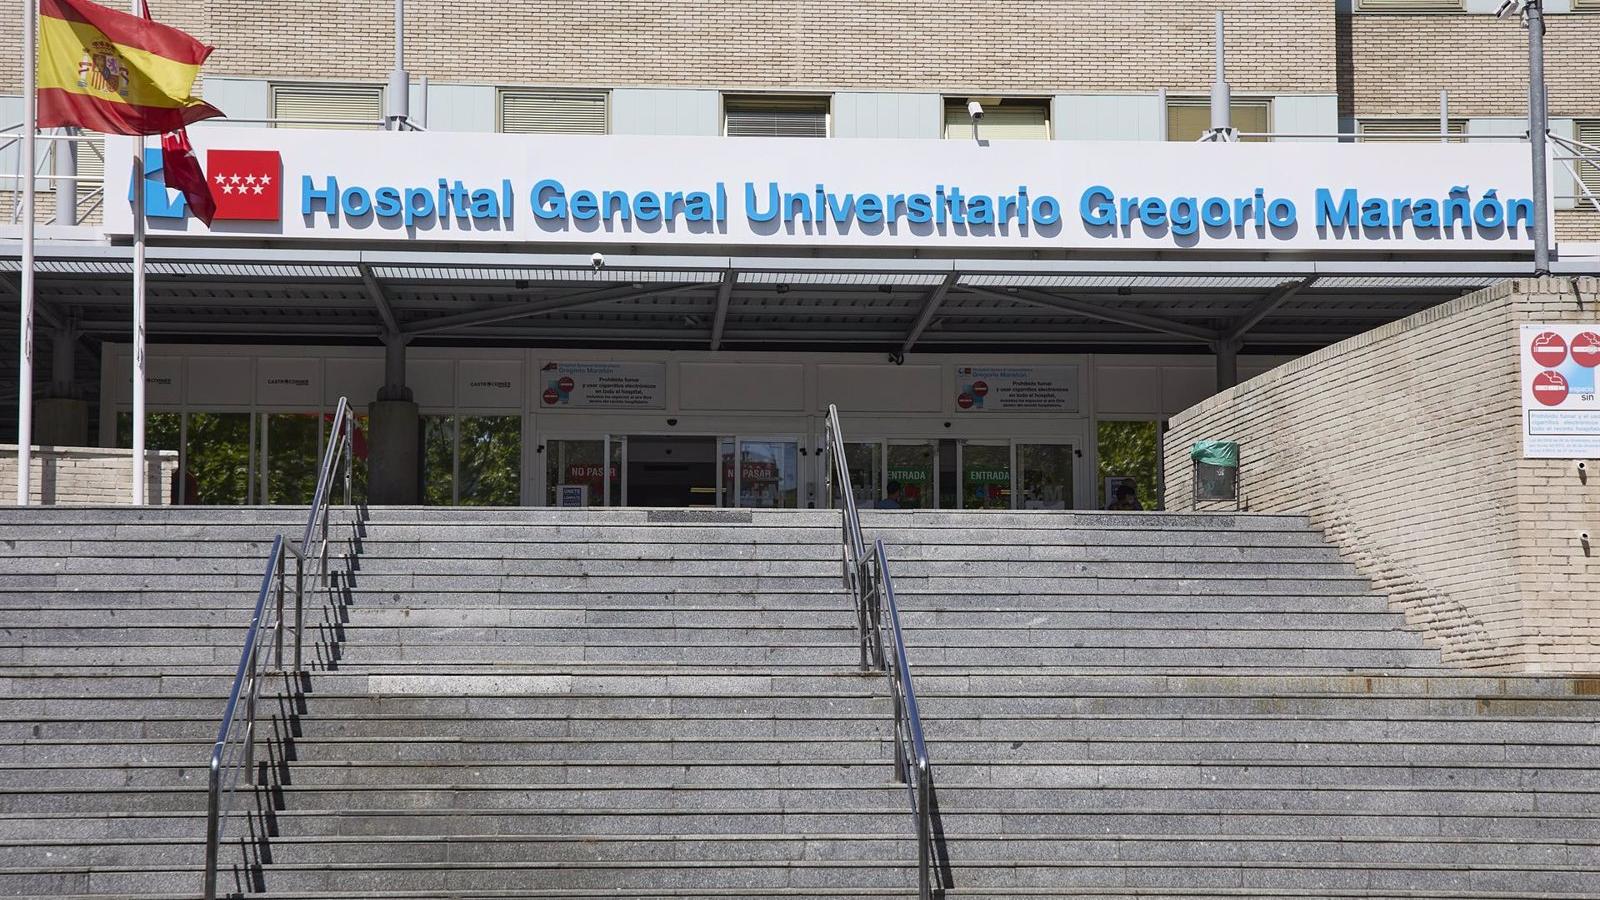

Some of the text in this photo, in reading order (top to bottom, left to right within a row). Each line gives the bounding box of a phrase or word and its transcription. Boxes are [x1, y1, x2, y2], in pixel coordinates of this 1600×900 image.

[301, 175, 1535, 236] Hospital General Universitario Gregorio Marañón
[1581, 392, 1594, 401] sin
[571, 467, 616, 477] NO PASR
[742, 468, 771, 479] PASAR
[887, 470, 926, 480] ENTRADA
[970, 471, 1010, 480] ENTRADA
